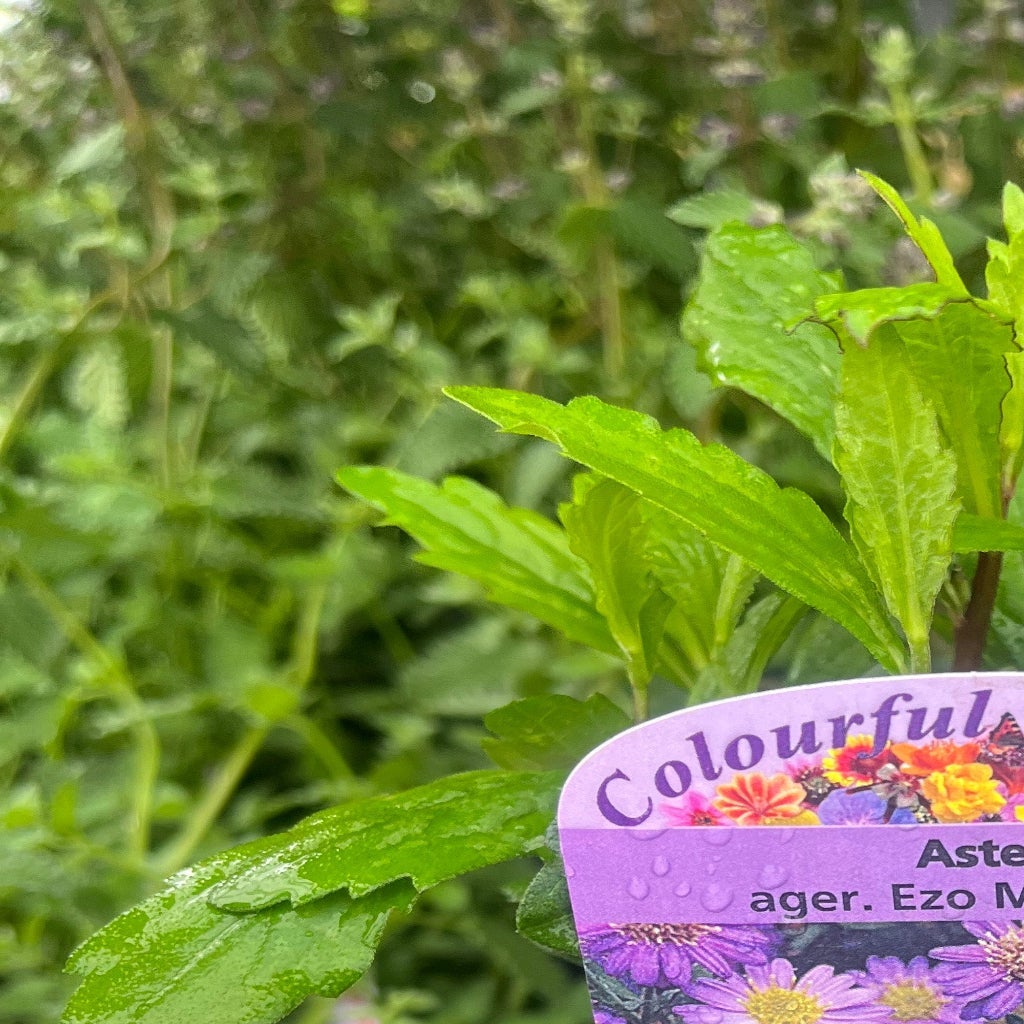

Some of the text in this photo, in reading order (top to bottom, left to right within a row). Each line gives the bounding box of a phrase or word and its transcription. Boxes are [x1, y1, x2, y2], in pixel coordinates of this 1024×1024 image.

[596, 689, 994, 828] Colourful
[750, 890, 873, 919] ager.
[891, 883, 976, 911] Ezo
